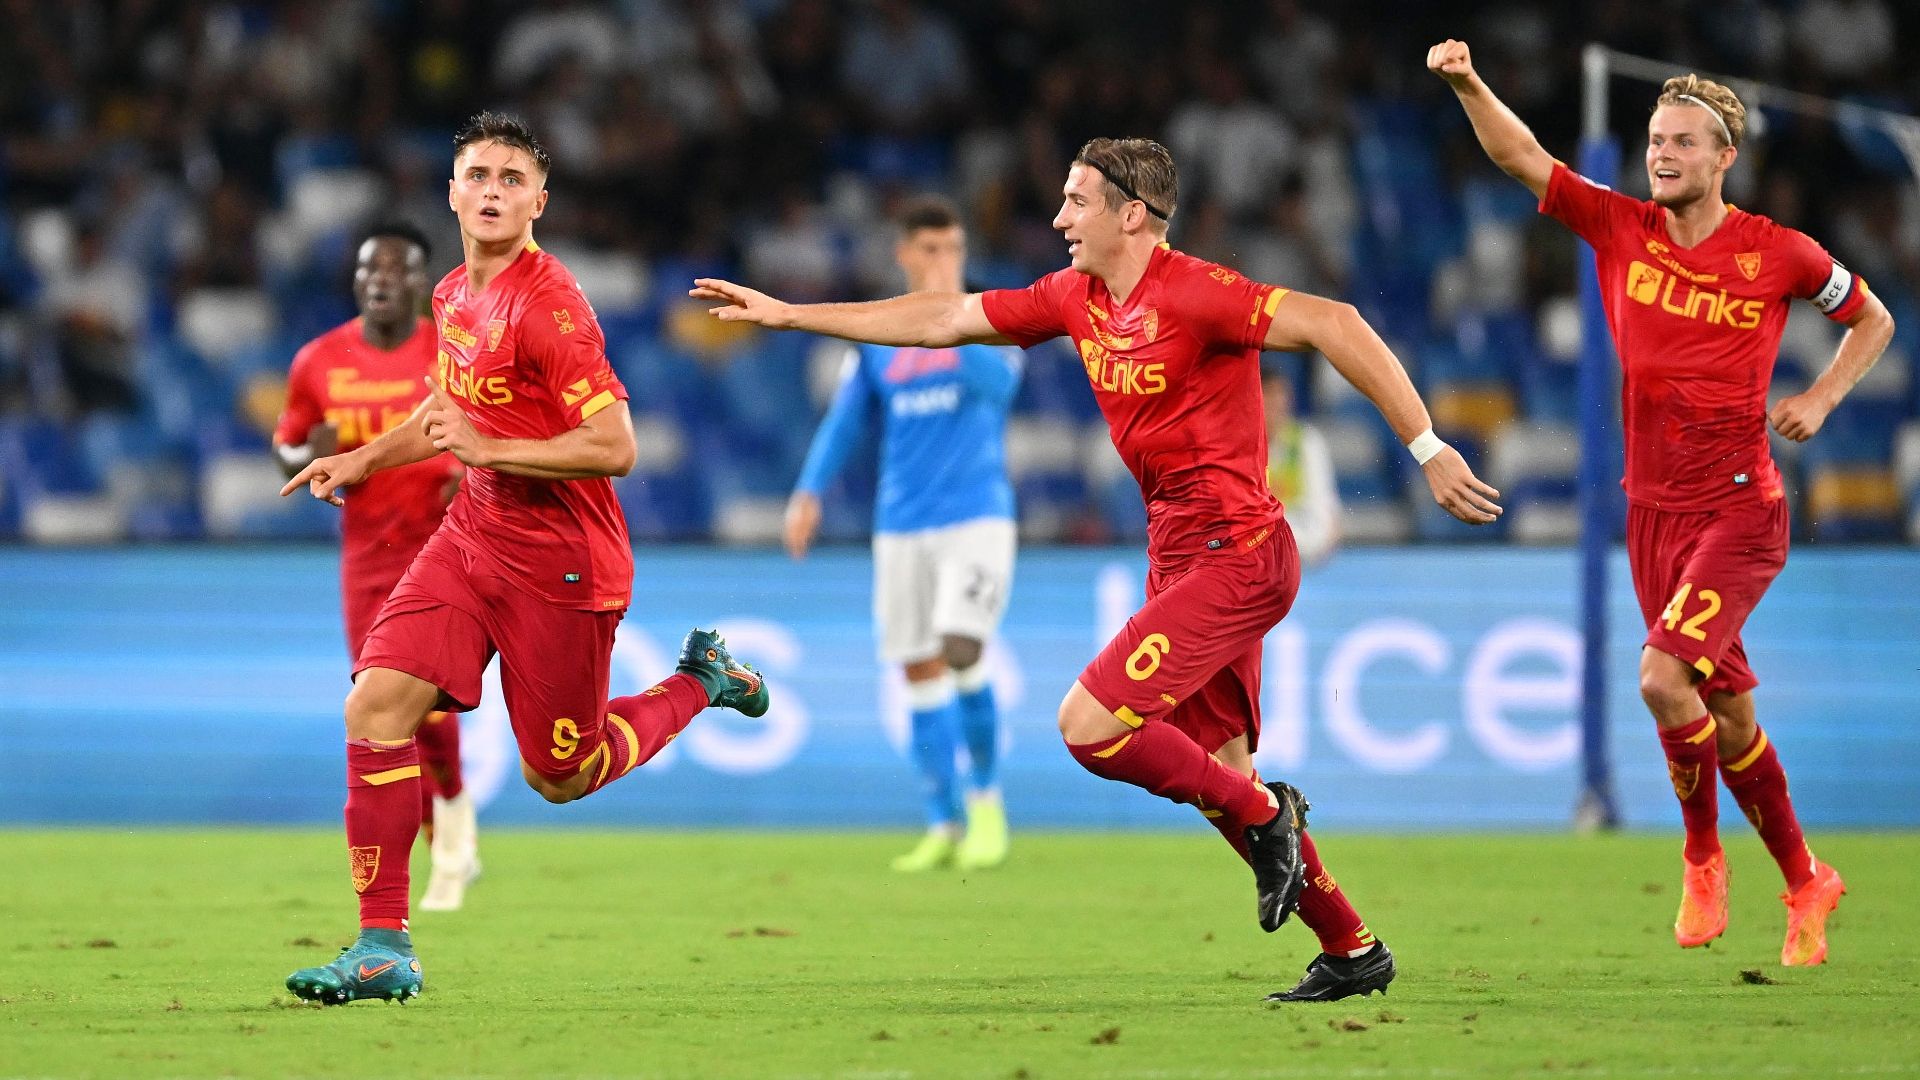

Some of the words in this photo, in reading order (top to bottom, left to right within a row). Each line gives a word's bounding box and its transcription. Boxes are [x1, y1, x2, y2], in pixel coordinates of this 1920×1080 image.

[1660, 274, 1765, 330] Links
[1661, 582, 1722, 642] 42
[1125, 632, 1170, 681] 6
[550, 717, 581, 760] 9
